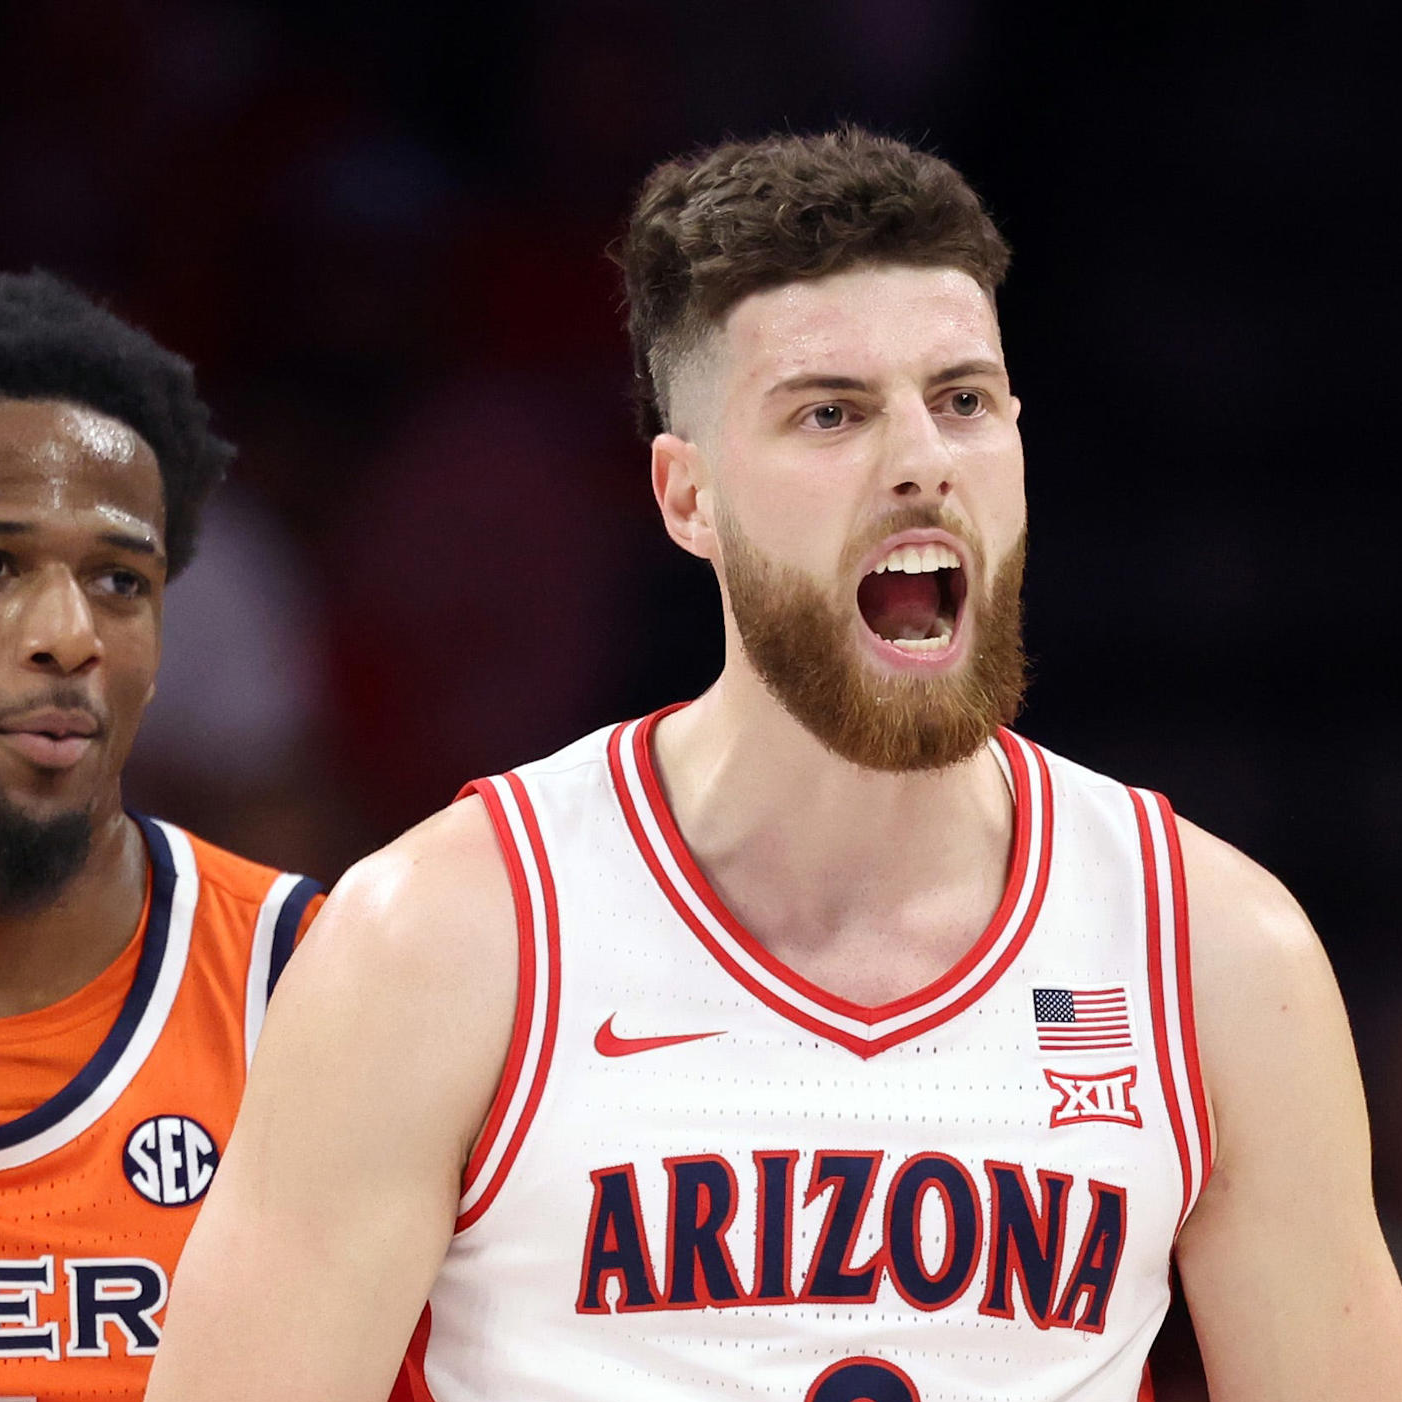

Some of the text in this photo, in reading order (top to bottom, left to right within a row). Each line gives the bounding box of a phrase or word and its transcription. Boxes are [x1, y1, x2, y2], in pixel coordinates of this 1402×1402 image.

[1045, 1068, 1141, 1126] XII
[125, 1116, 216, 1204] SEC
[576, 1149, 1127, 1334] ARIZONA
